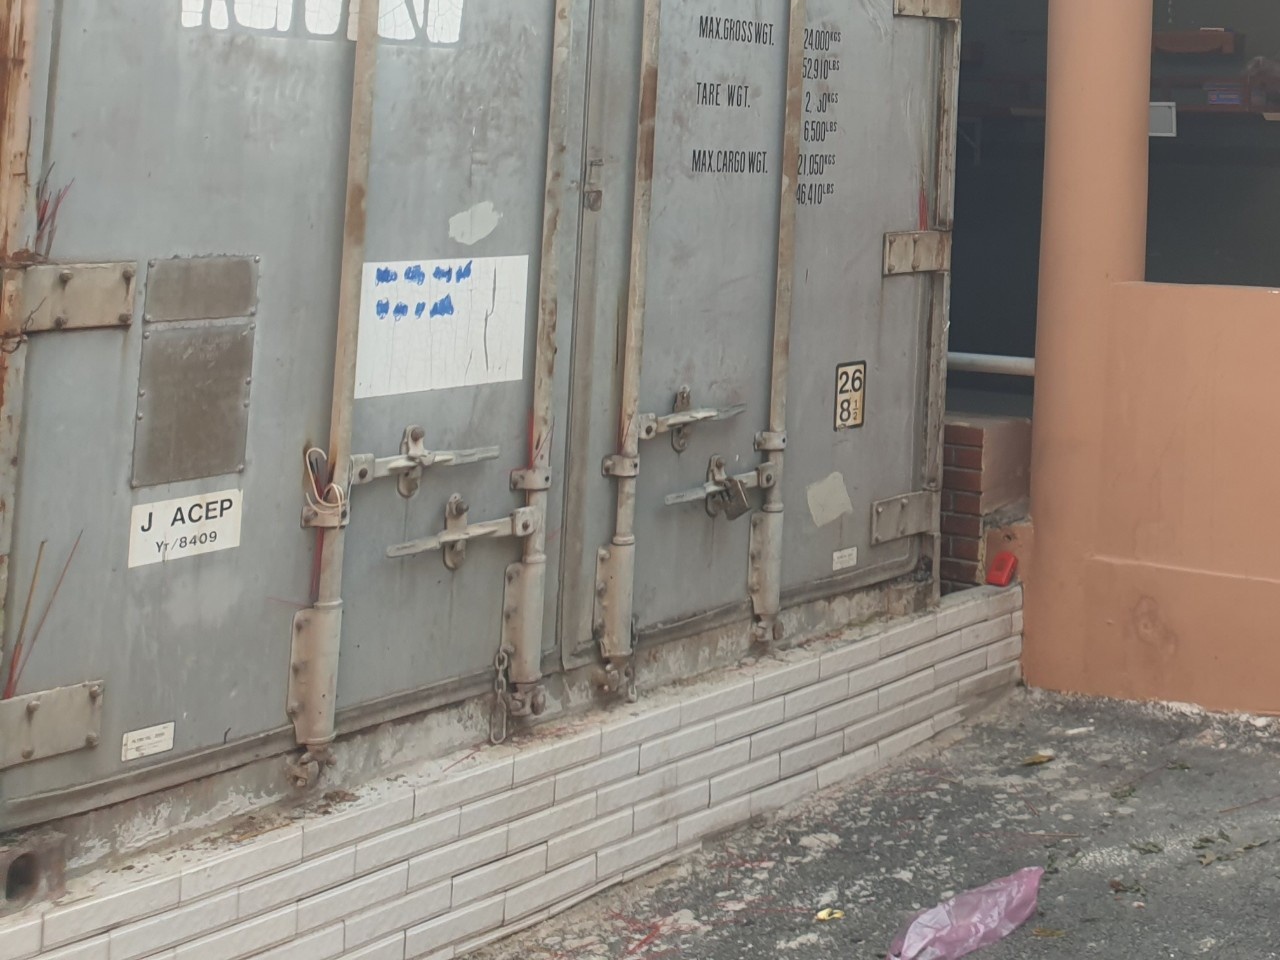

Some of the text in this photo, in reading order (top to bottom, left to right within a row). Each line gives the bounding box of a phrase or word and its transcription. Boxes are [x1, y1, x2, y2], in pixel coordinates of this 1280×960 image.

[696, 82, 722, 107] TARE
[727, 84, 751, 109] WGT.
[748, 151, 769, 175] WGT.
[140, 497, 234, 533] J ACEP
